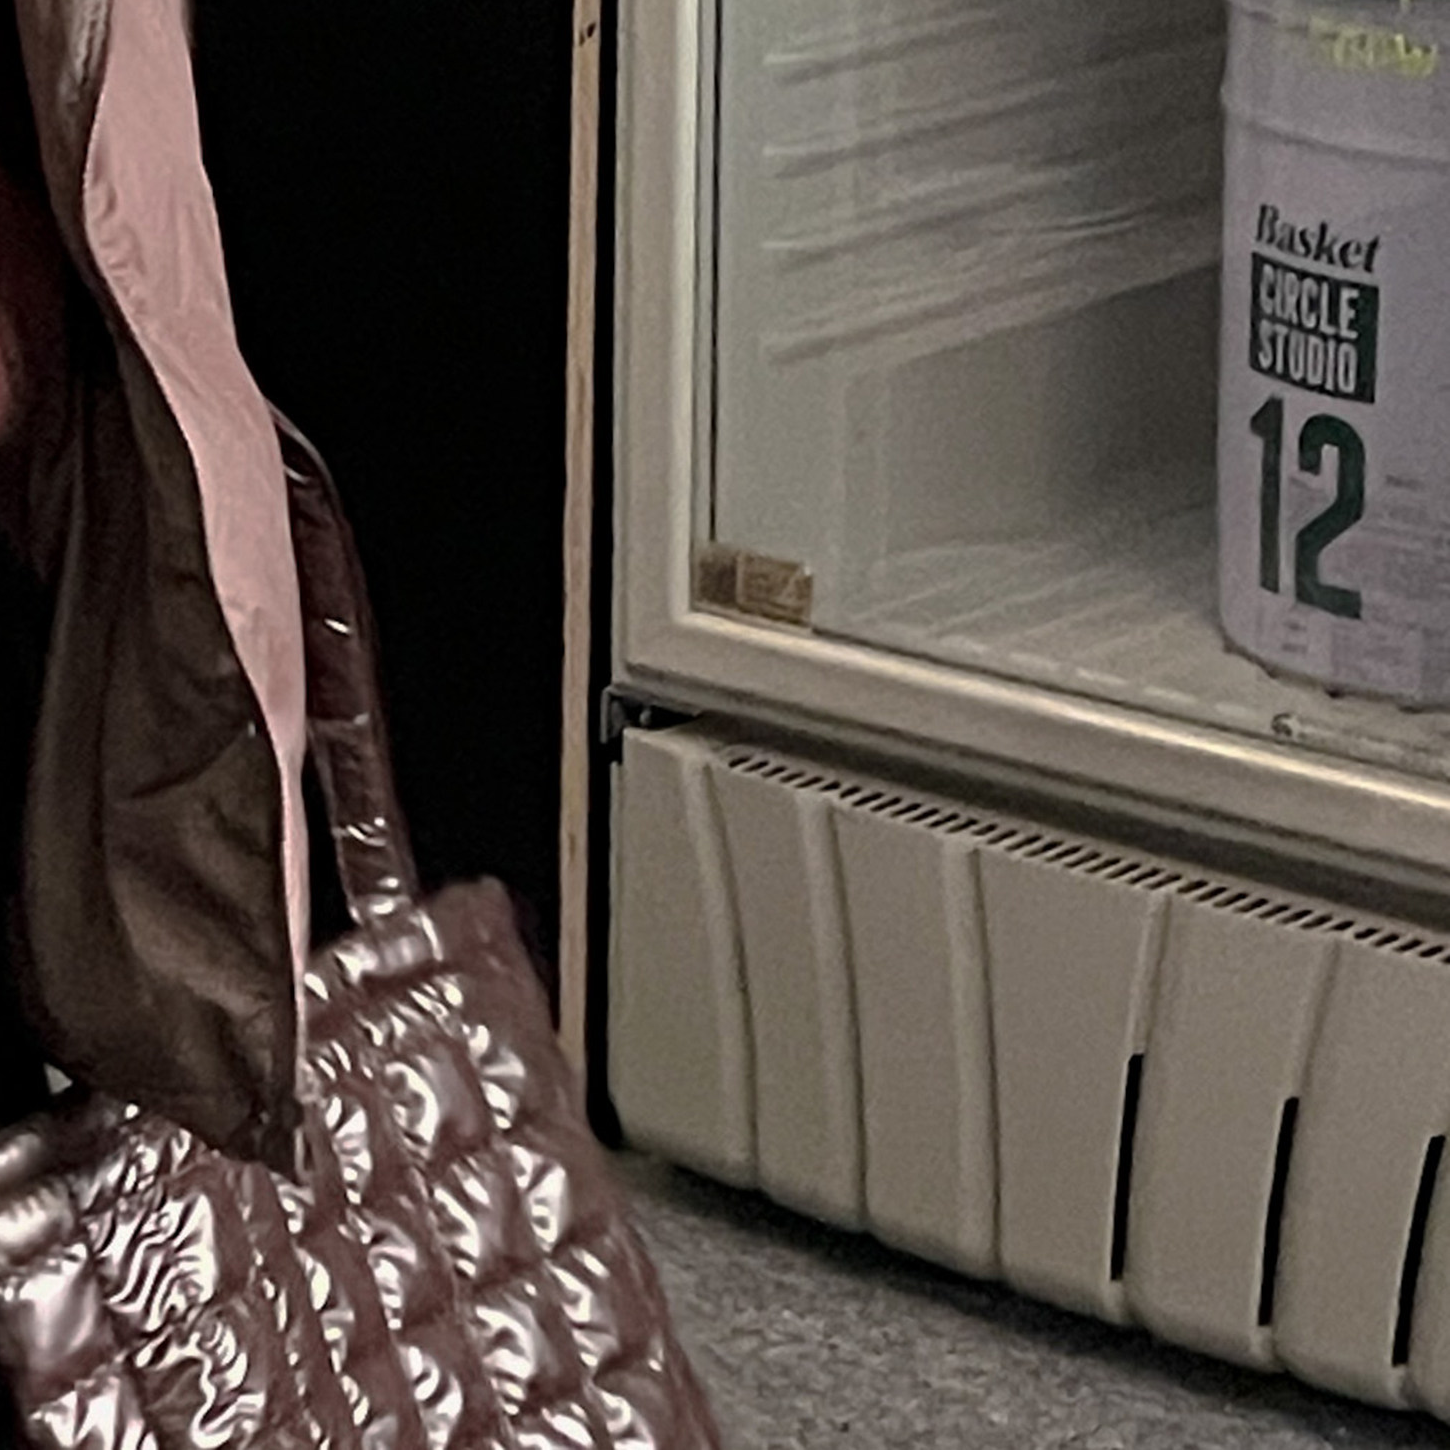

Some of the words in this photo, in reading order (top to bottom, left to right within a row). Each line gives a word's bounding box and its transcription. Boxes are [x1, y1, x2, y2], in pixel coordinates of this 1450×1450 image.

[1255, 203, 1380, 274] Basket
[1259, 263, 1360, 340] CIRCLE
[1257, 318, 1359, 395] STUDIO
[1249, 393, 1366, 620] 12
